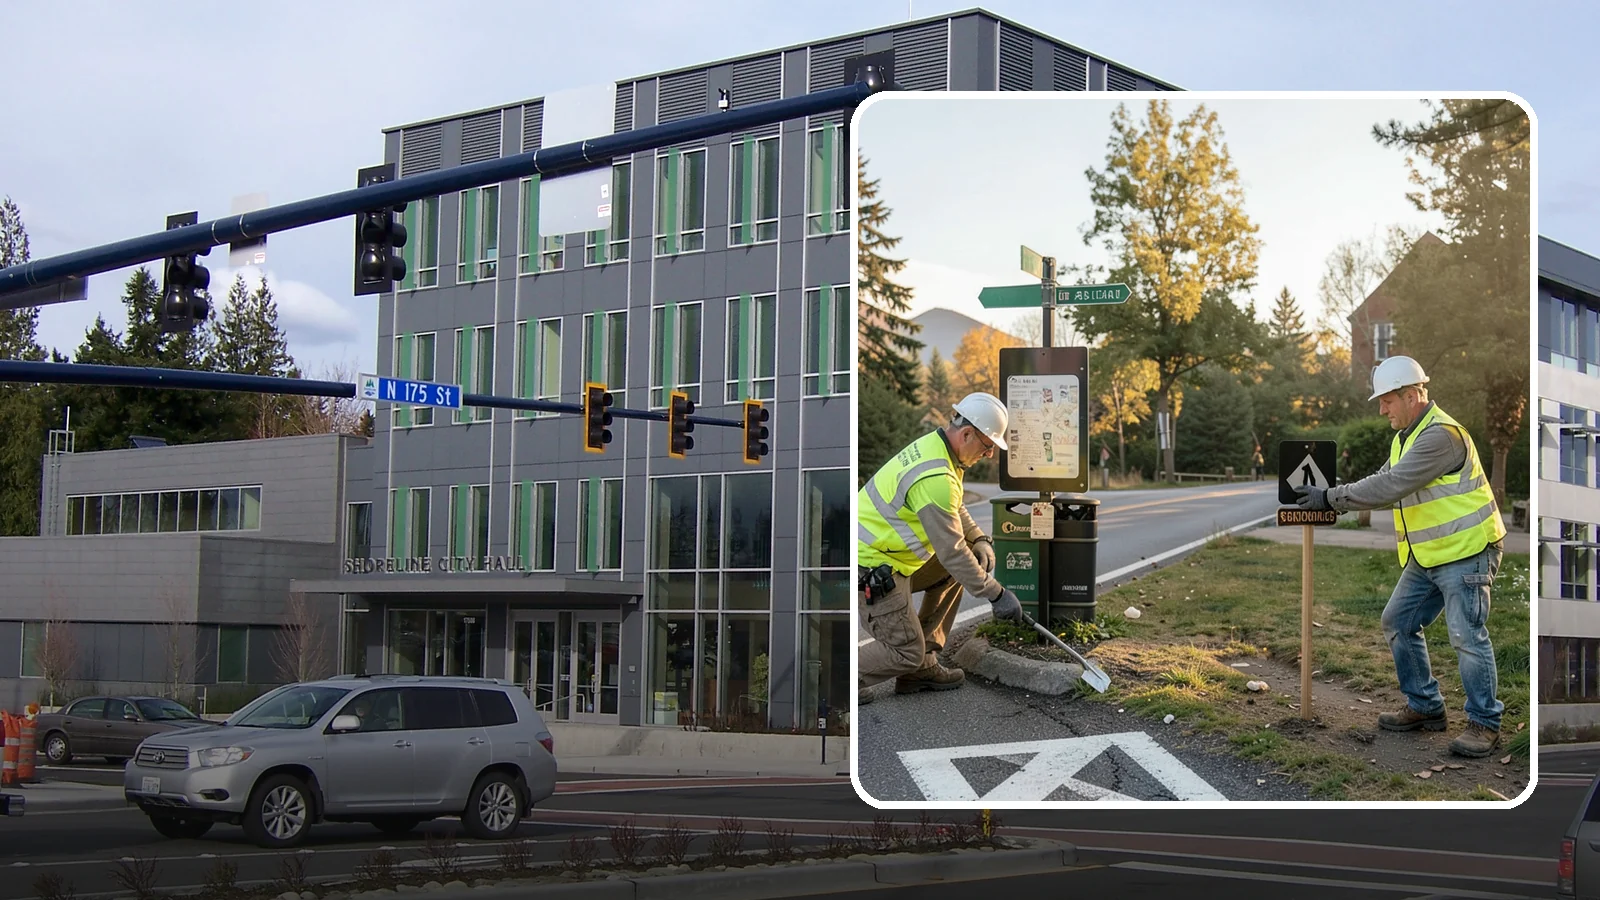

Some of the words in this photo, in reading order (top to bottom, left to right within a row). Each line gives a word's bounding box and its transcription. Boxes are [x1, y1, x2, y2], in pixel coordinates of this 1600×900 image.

[387, 380, 396, 400] N
[405, 383, 428, 403] 175
[436, 386, 451, 406] St
[344, 556, 432, 574] SHORELINE
[438, 556, 476, 573] CITY
[484, 555, 526, 572] HALL
